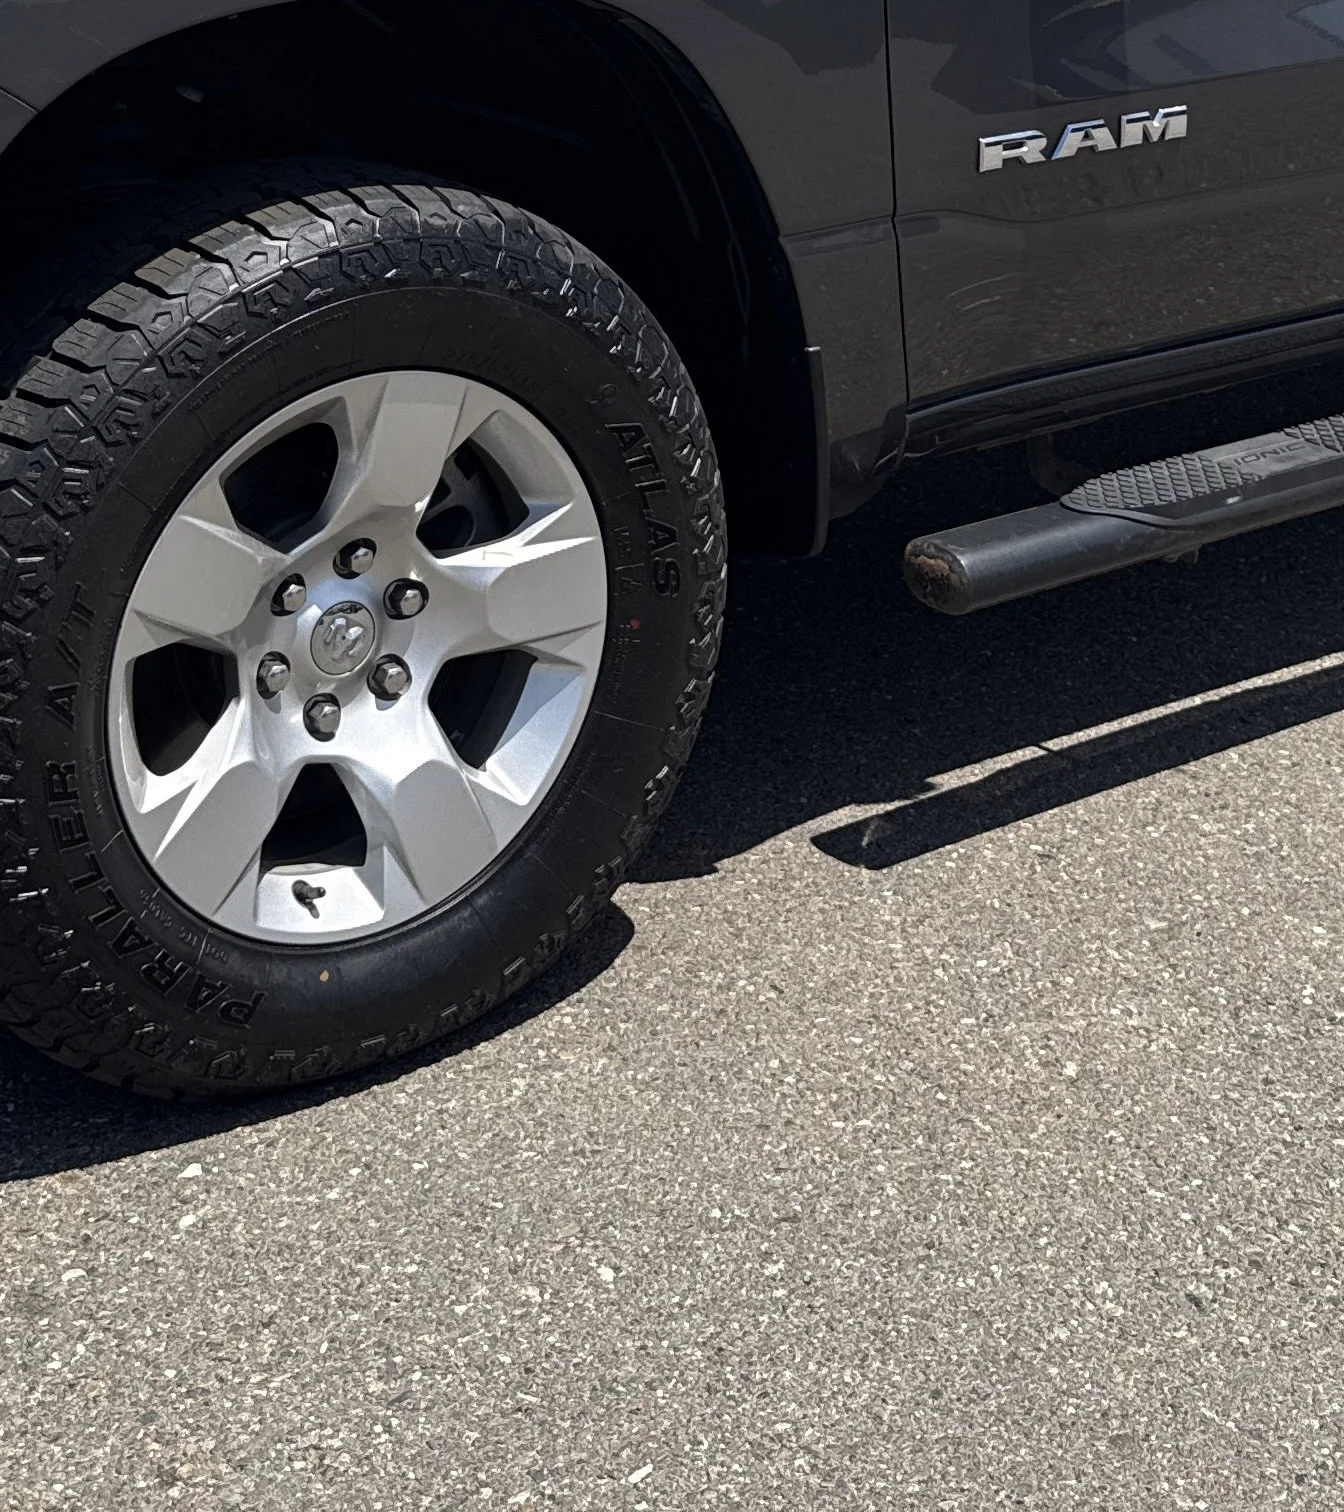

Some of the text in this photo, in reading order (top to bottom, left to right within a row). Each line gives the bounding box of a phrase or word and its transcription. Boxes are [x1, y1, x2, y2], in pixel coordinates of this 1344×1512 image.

[978, 104, 1188, 173] RAM
[604, 422, 681, 598] ATLAS
[45, 579, 97, 731] A/T
[44, 759, 268, 1030] PARALLER
